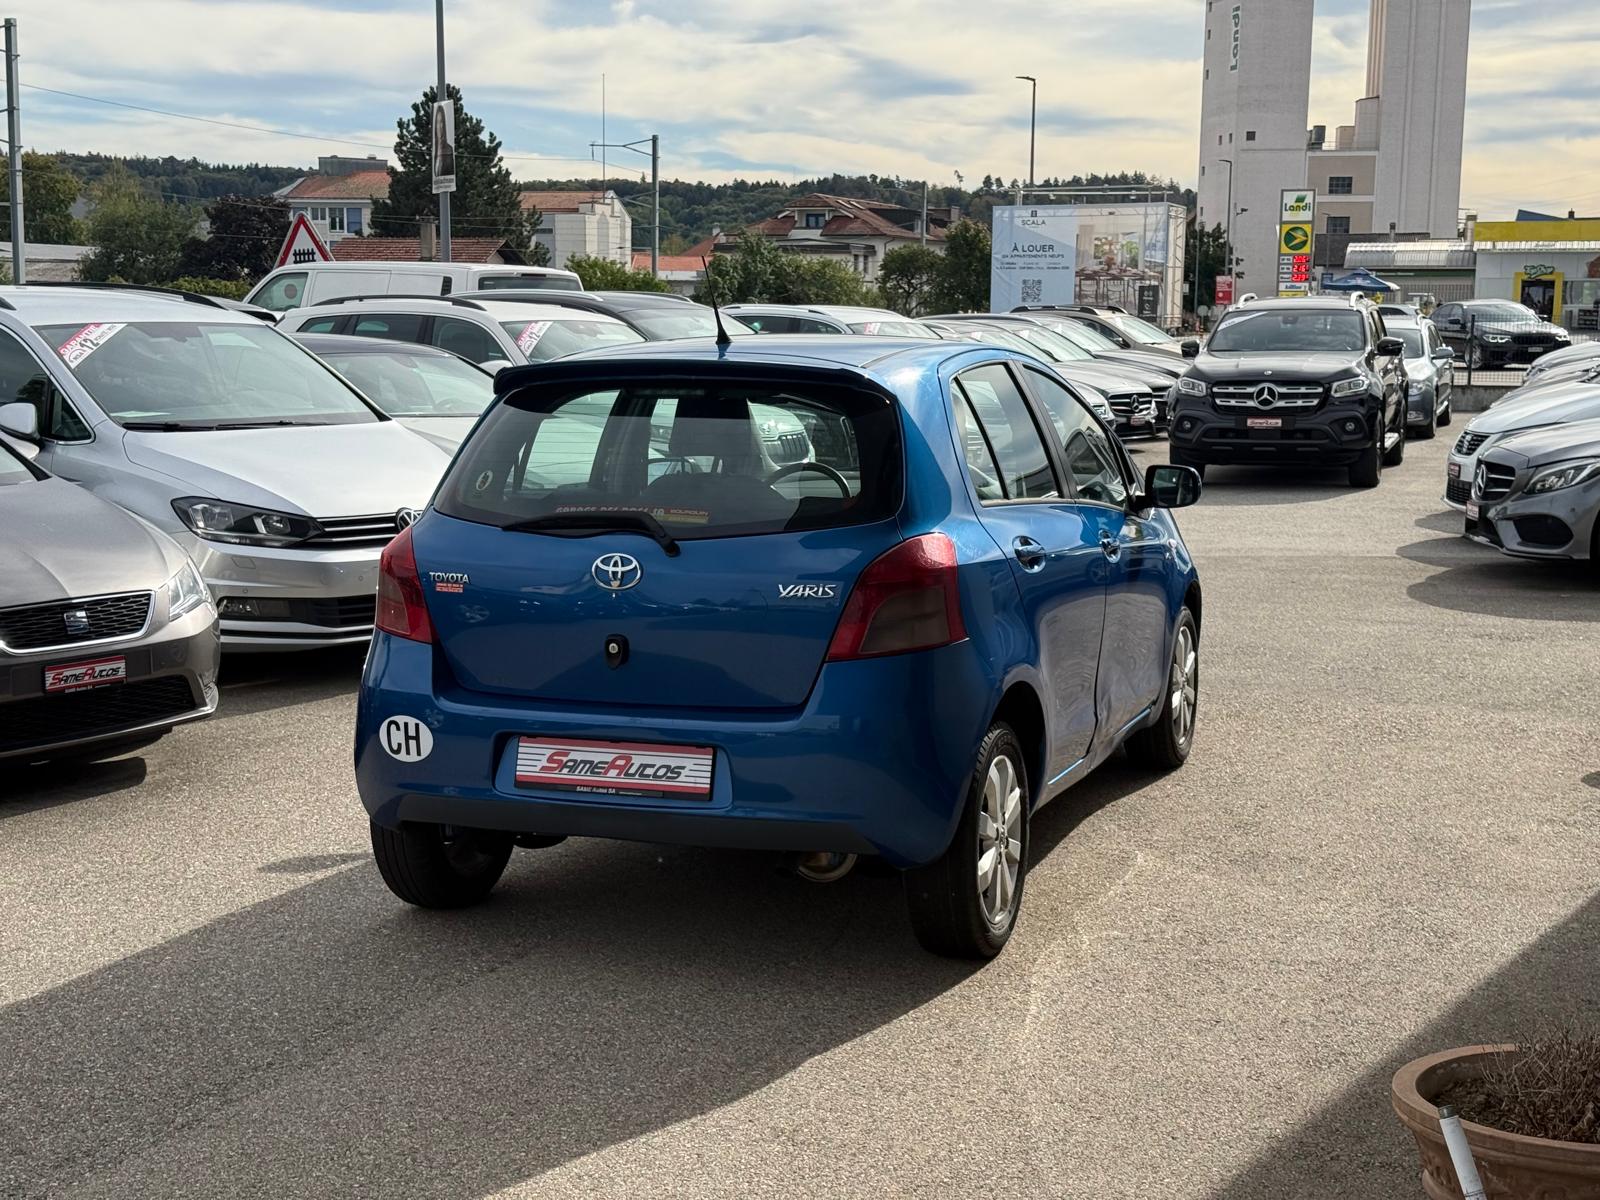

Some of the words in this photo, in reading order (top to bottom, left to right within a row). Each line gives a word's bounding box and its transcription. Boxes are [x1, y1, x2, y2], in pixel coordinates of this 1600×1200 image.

[1230, 5, 1241, 71] Landi
[1284, 202, 1311, 212] Landi
[1022, 244, 1055, 253] LOUER
[79, 338, 100, 350] 12
[429, 571, 470, 584] TOYOTA
[778, 583, 837, 598] YARIS
[386, 719, 422, 757] CH
